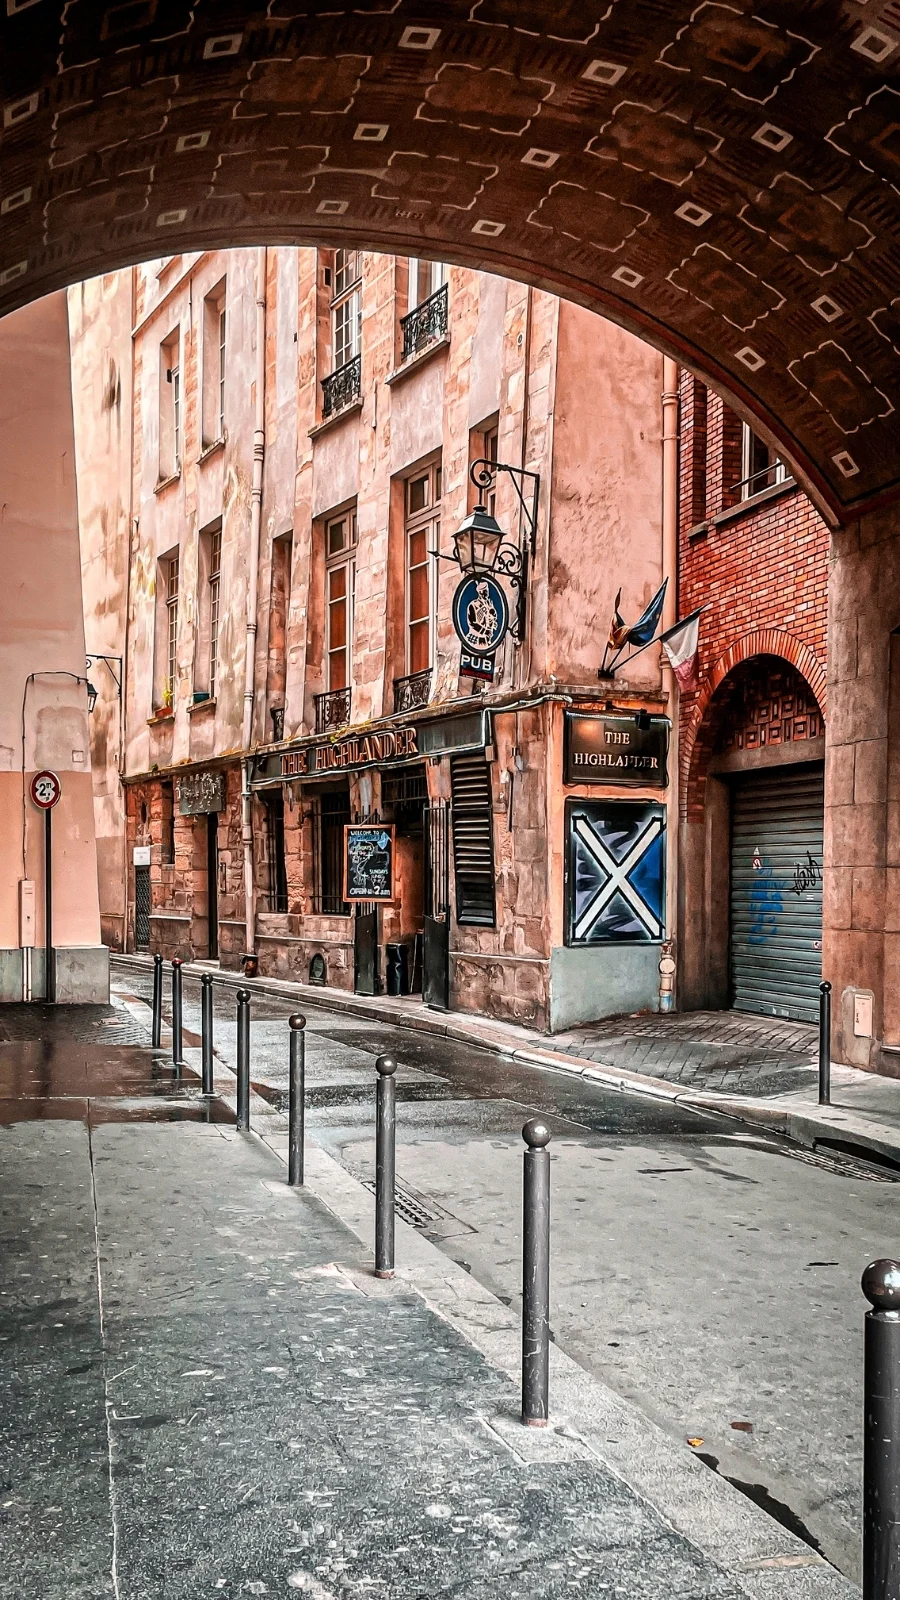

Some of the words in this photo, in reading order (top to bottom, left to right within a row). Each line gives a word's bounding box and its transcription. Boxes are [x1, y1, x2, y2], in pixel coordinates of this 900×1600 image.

[460, 654, 492, 671] PUB
[604, 731, 630, 745] THE
[280, 750, 307, 776] THE
[315, 727, 419, 770] HIGHLANDER
[350, 887, 367, 895] OPEN
